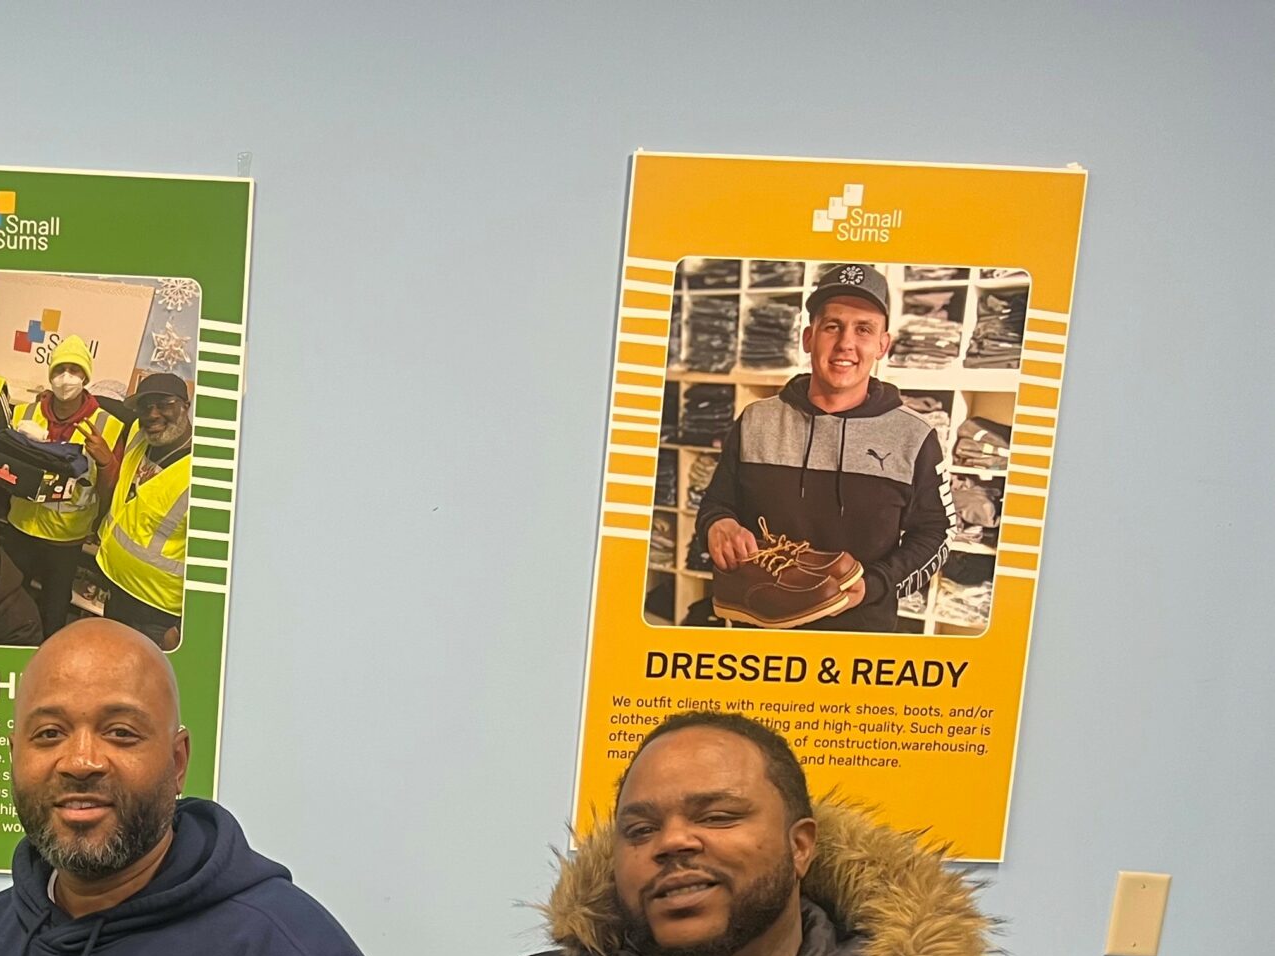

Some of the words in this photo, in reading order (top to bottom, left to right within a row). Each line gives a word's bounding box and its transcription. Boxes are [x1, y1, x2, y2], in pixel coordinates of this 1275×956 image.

[5, 214, 60, 236] Small
[849, 208, 902, 228] Small
[836, 223, 890, 243] Sums
[47, 333, 99, 359] Sll
[644, 651, 808, 684] DRESSED
[817, 658, 840, 684] &
[850, 659, 969, 688] READY
[612, 695, 631, 707] We
[636, 696, 672, 709] outfit
[677, 698, 721, 710] clients
[726, 700, 754, 711] with
[759, 701, 814, 714] required
[819, 702, 851, 714] work
[855, 704, 898, 716] shoes,
[903, 705, 944, 718] boots,
[948, 706, 994, 719] and/or
[610, 713, 659, 725] clothes
[794, 719, 819, 730] and
[823, 719, 906, 735] high-quality.
[910, 722, 944, 734] Such
[947, 725, 976, 737] gear
[980, 724, 991, 736] is
[608, 730, 644, 742] often
[794, 736, 808, 747] of
[800, 754, 824, 765] and
[829, 755, 901, 768] healthcare.
